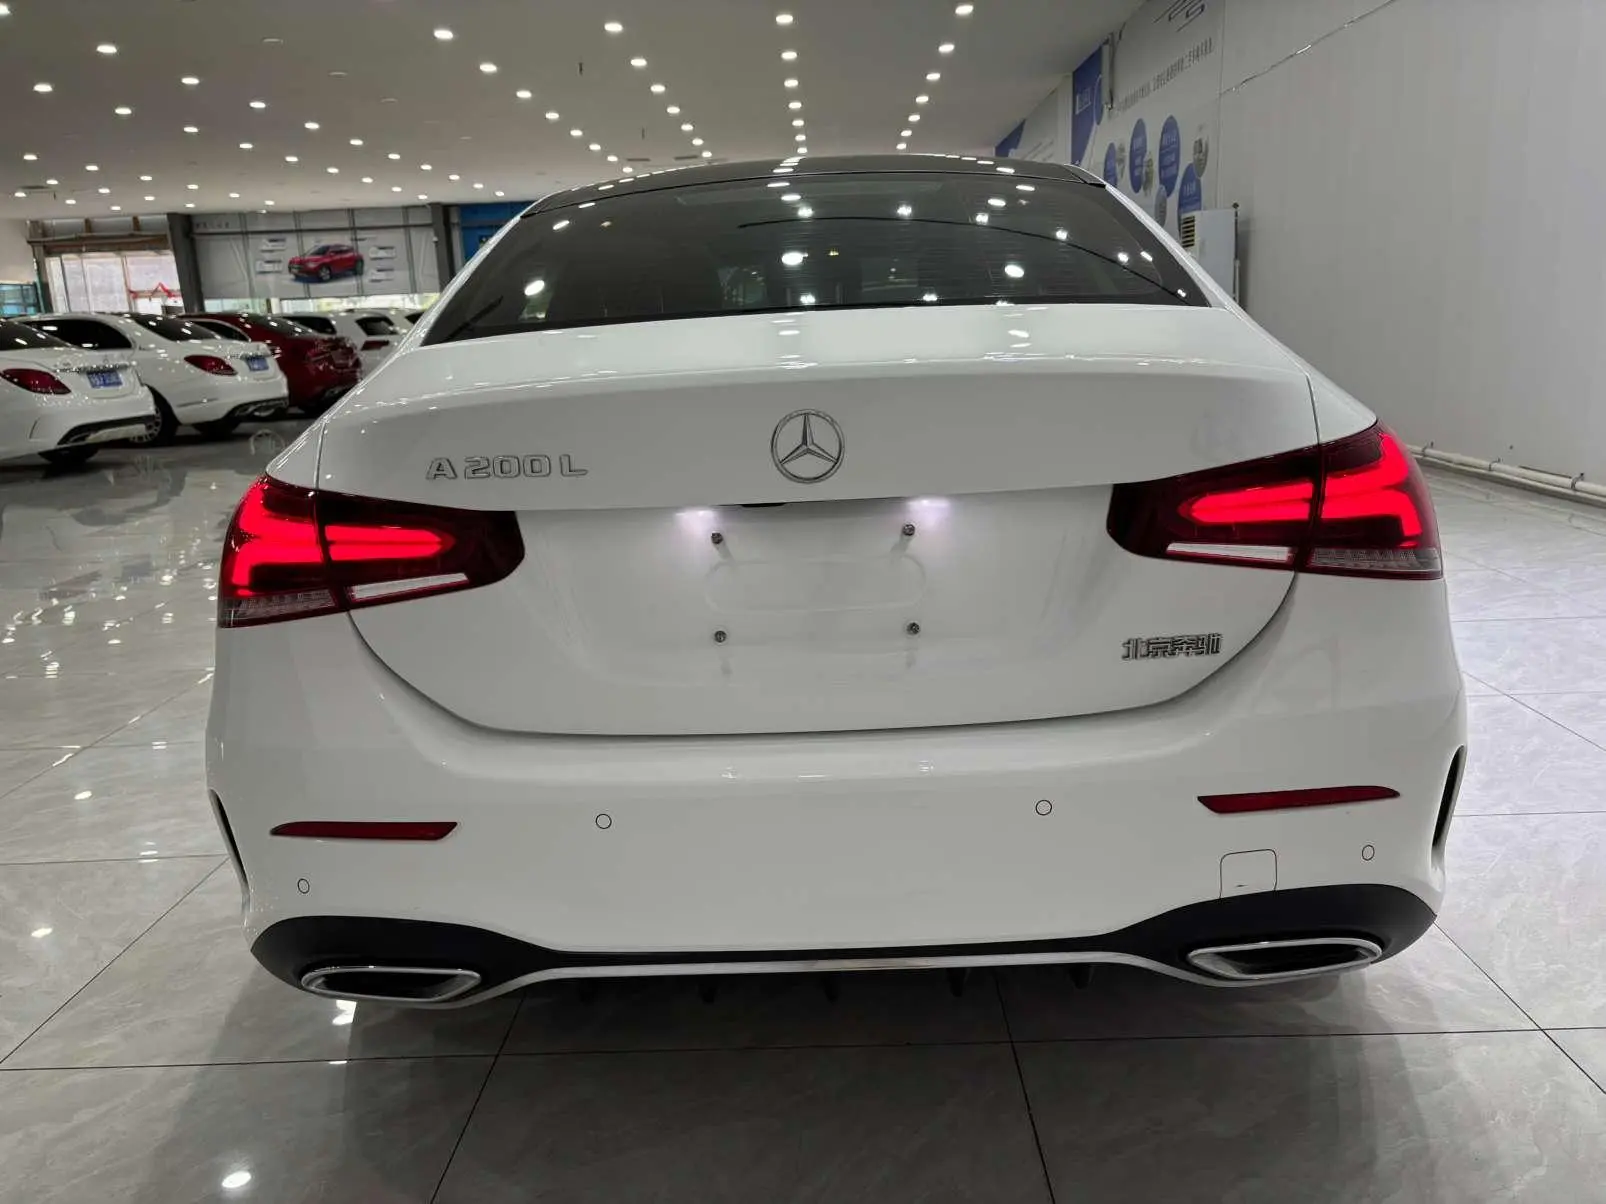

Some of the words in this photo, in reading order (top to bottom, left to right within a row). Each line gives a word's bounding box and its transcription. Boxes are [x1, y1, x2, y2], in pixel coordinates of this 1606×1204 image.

[426, 457, 458, 480] A
[464, 454, 551, 479] 200
[559, 453, 589, 478] L
[1121, 634, 1222, 660] 北京奔驰
